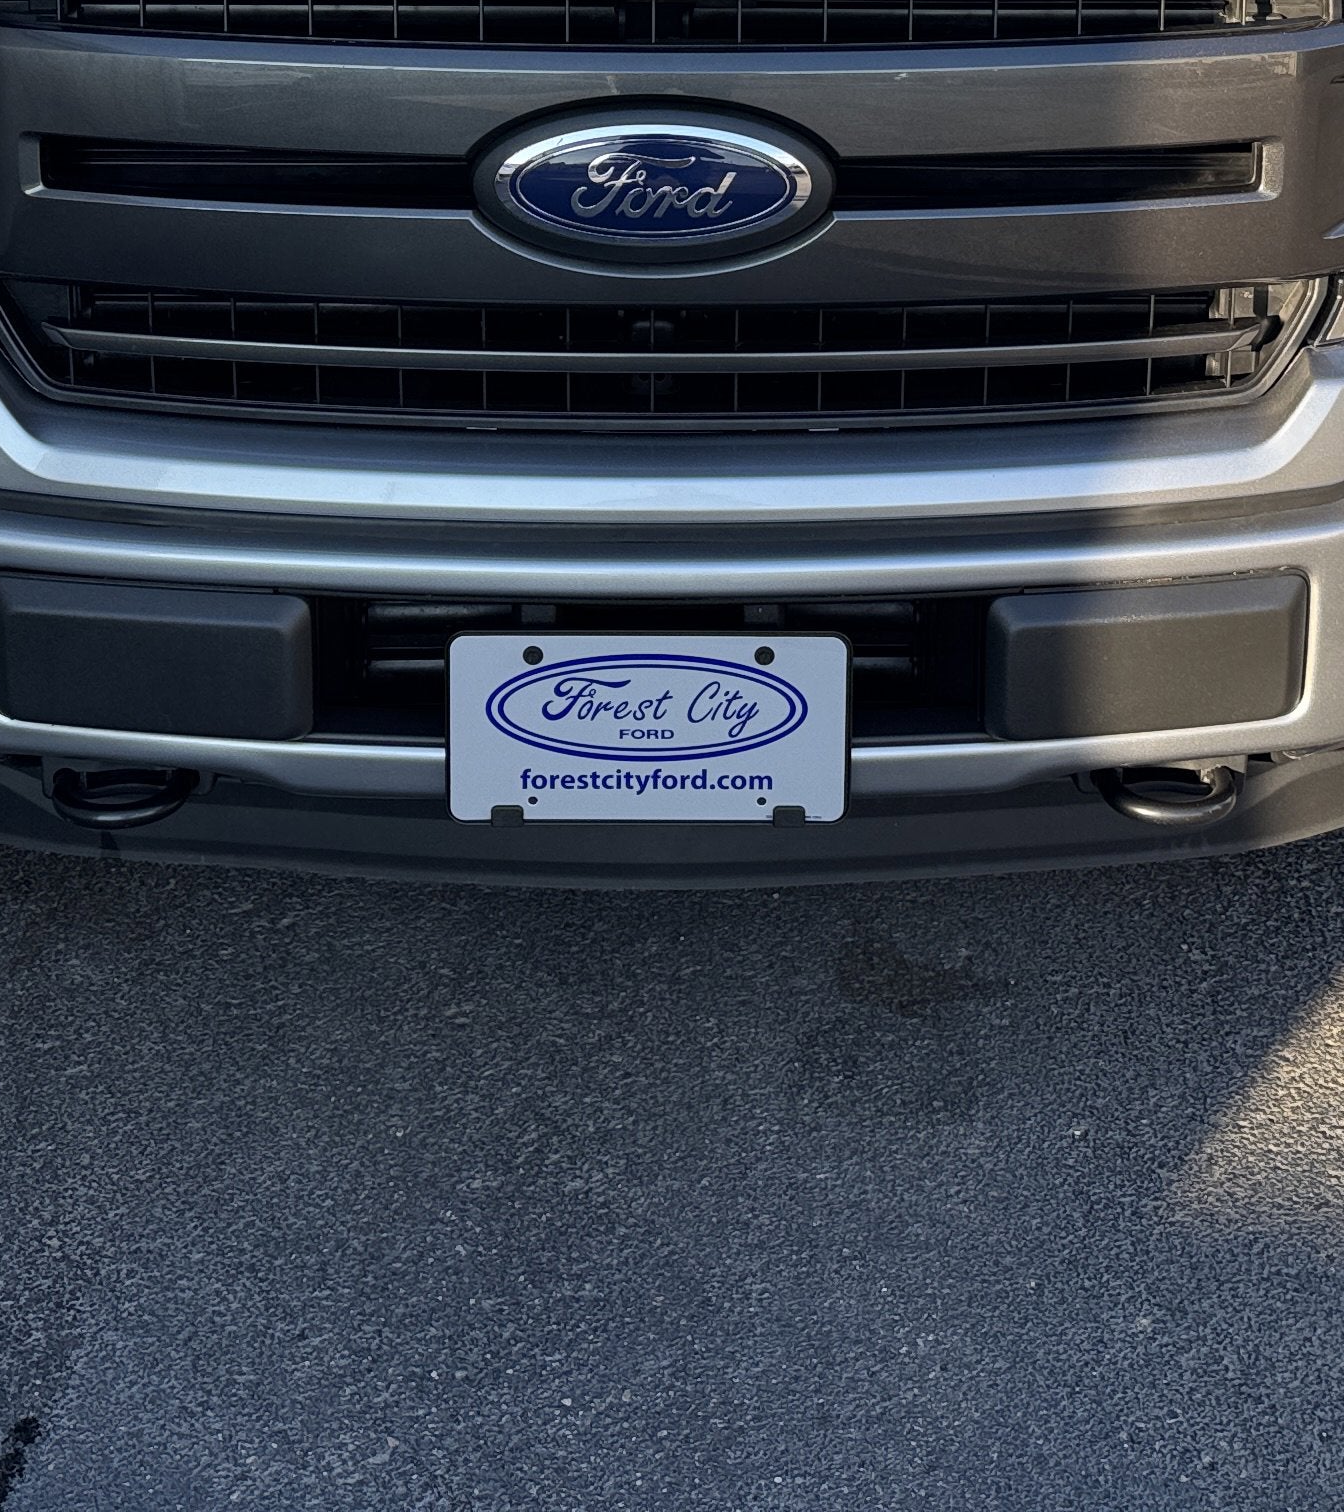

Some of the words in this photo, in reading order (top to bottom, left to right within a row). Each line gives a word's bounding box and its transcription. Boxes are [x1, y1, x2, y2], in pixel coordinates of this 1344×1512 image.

[570, 152, 735, 219] Ford
[541, 677, 674, 722] Forest
[687, 681, 760, 738] City
[618, 728, 675, 740] FORD
[519, 768, 774, 795] forestcityford.com
